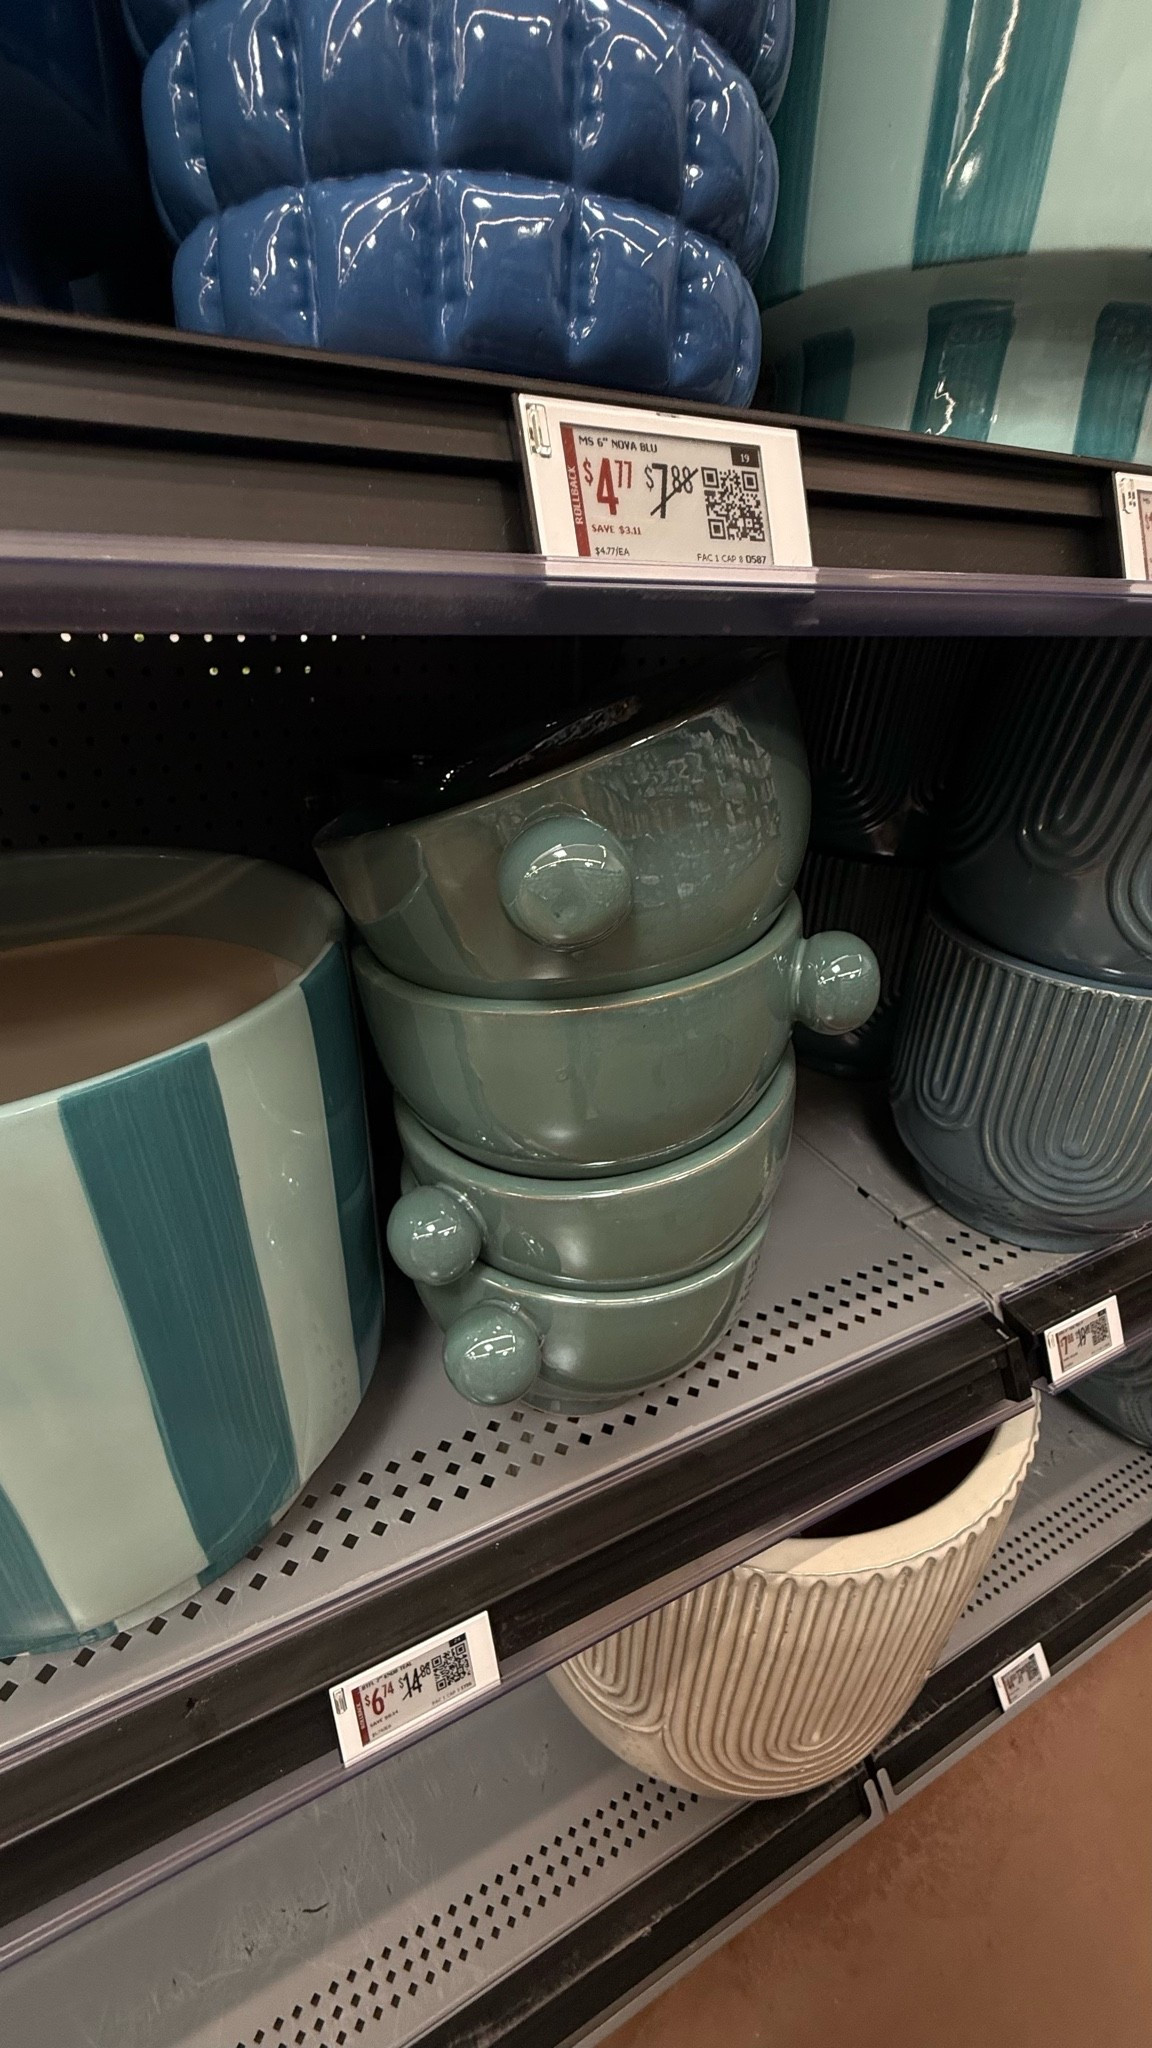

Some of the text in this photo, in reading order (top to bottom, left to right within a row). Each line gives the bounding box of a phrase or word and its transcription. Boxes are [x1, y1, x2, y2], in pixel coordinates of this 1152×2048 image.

[578, 435, 594, 446] MS
[611, 439, 637, 451] NOVA
[639, 443, 658, 453] BLU
[739, 452, 751, 464] 19
[566, 465, 584, 526] ROLLBACK
[591, 523, 642, 536] SAVE $3.11
[594, 546, 631, 557] $4.77/EA
[696, 553, 713, 562] FAC
[721, 554, 737, 563] CAP
[745, 554, 767, 564] 0587
